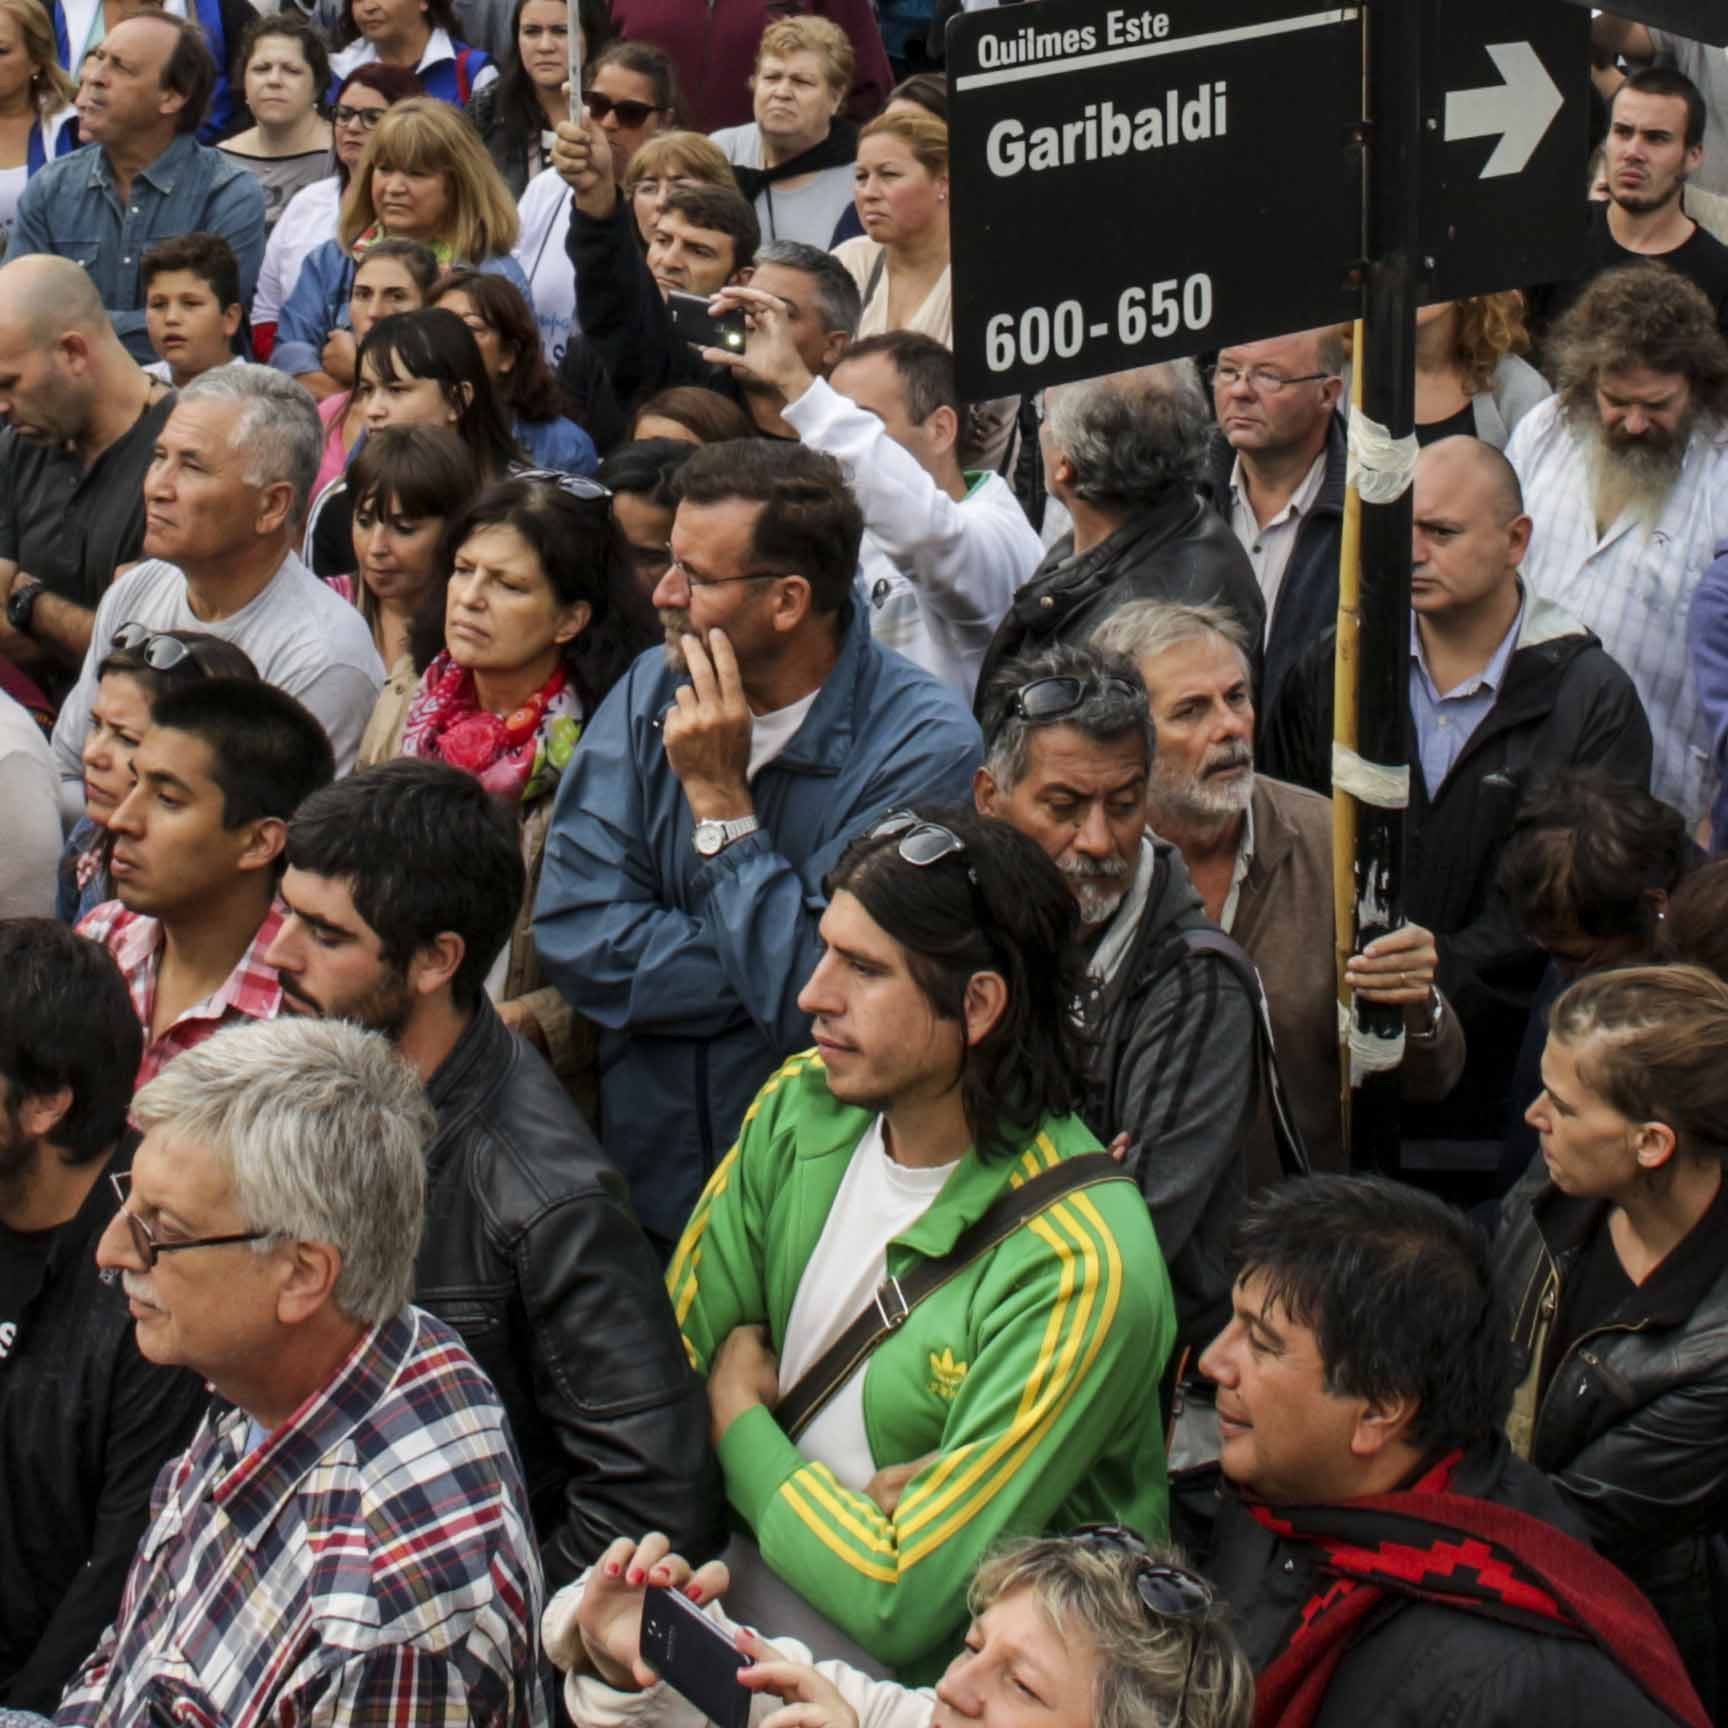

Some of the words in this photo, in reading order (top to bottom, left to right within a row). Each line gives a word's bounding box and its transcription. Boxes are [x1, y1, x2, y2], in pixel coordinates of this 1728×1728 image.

[977, 25, 1096, 71] Quilmes
[1106, 9, 1170, 47] Este
[986, 81, 1229, 179] Garibaldi
[985, 273, 1214, 373] 600-650
